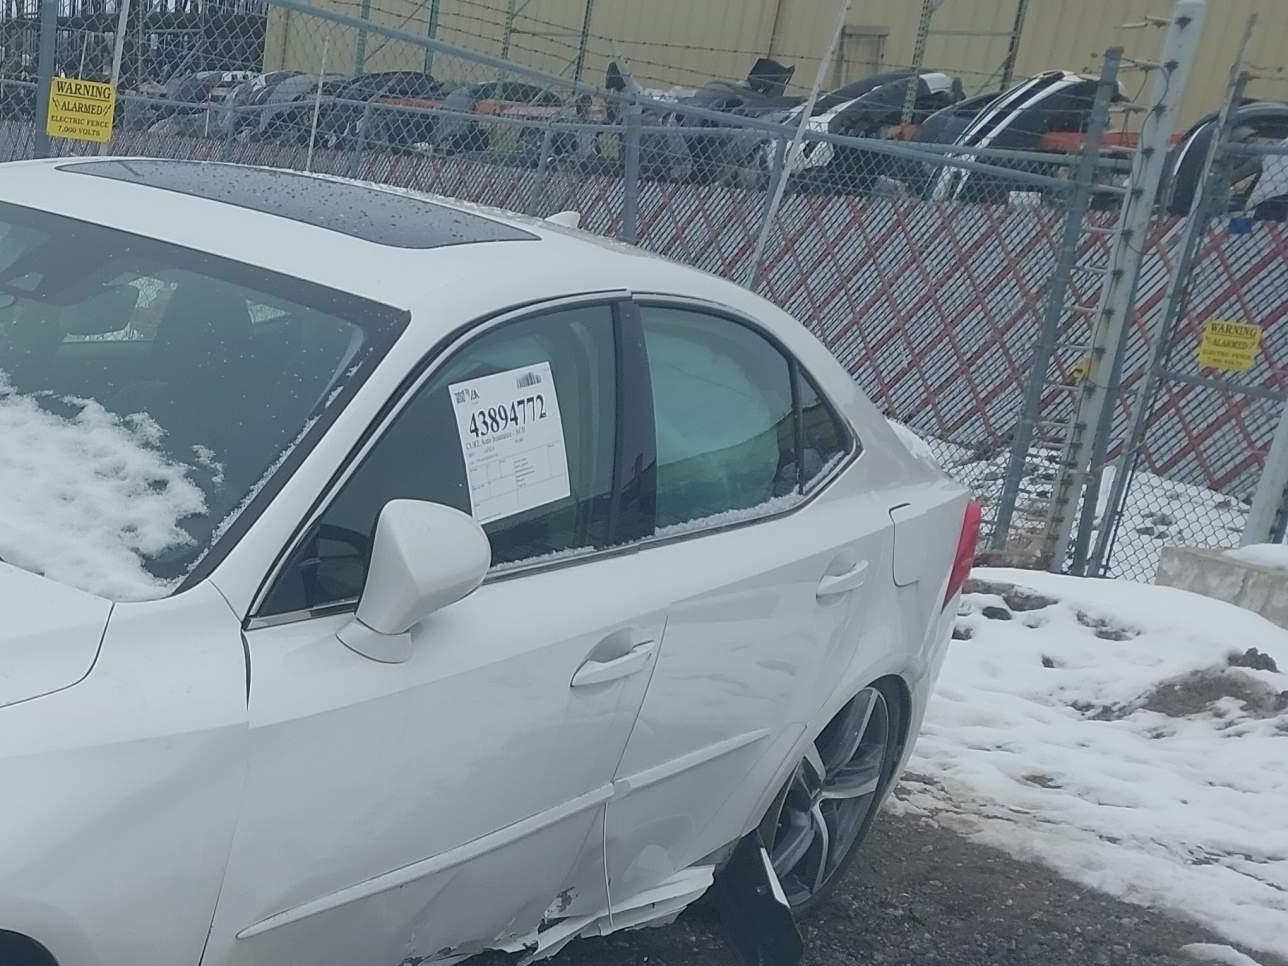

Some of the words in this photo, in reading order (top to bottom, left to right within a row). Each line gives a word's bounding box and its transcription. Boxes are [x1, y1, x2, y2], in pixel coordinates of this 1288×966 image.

[56, 81, 111, 99] WARNING
[61, 101, 103, 115] ALARMED
[51, 115, 85, 125] ELECTRIC
[87, 119, 110, 128] FENCE
[78, 128, 101, 137] VOLTS
[1211, 322, 1257, 337] WARNING
[469, 394, 547, 437] 43894772
